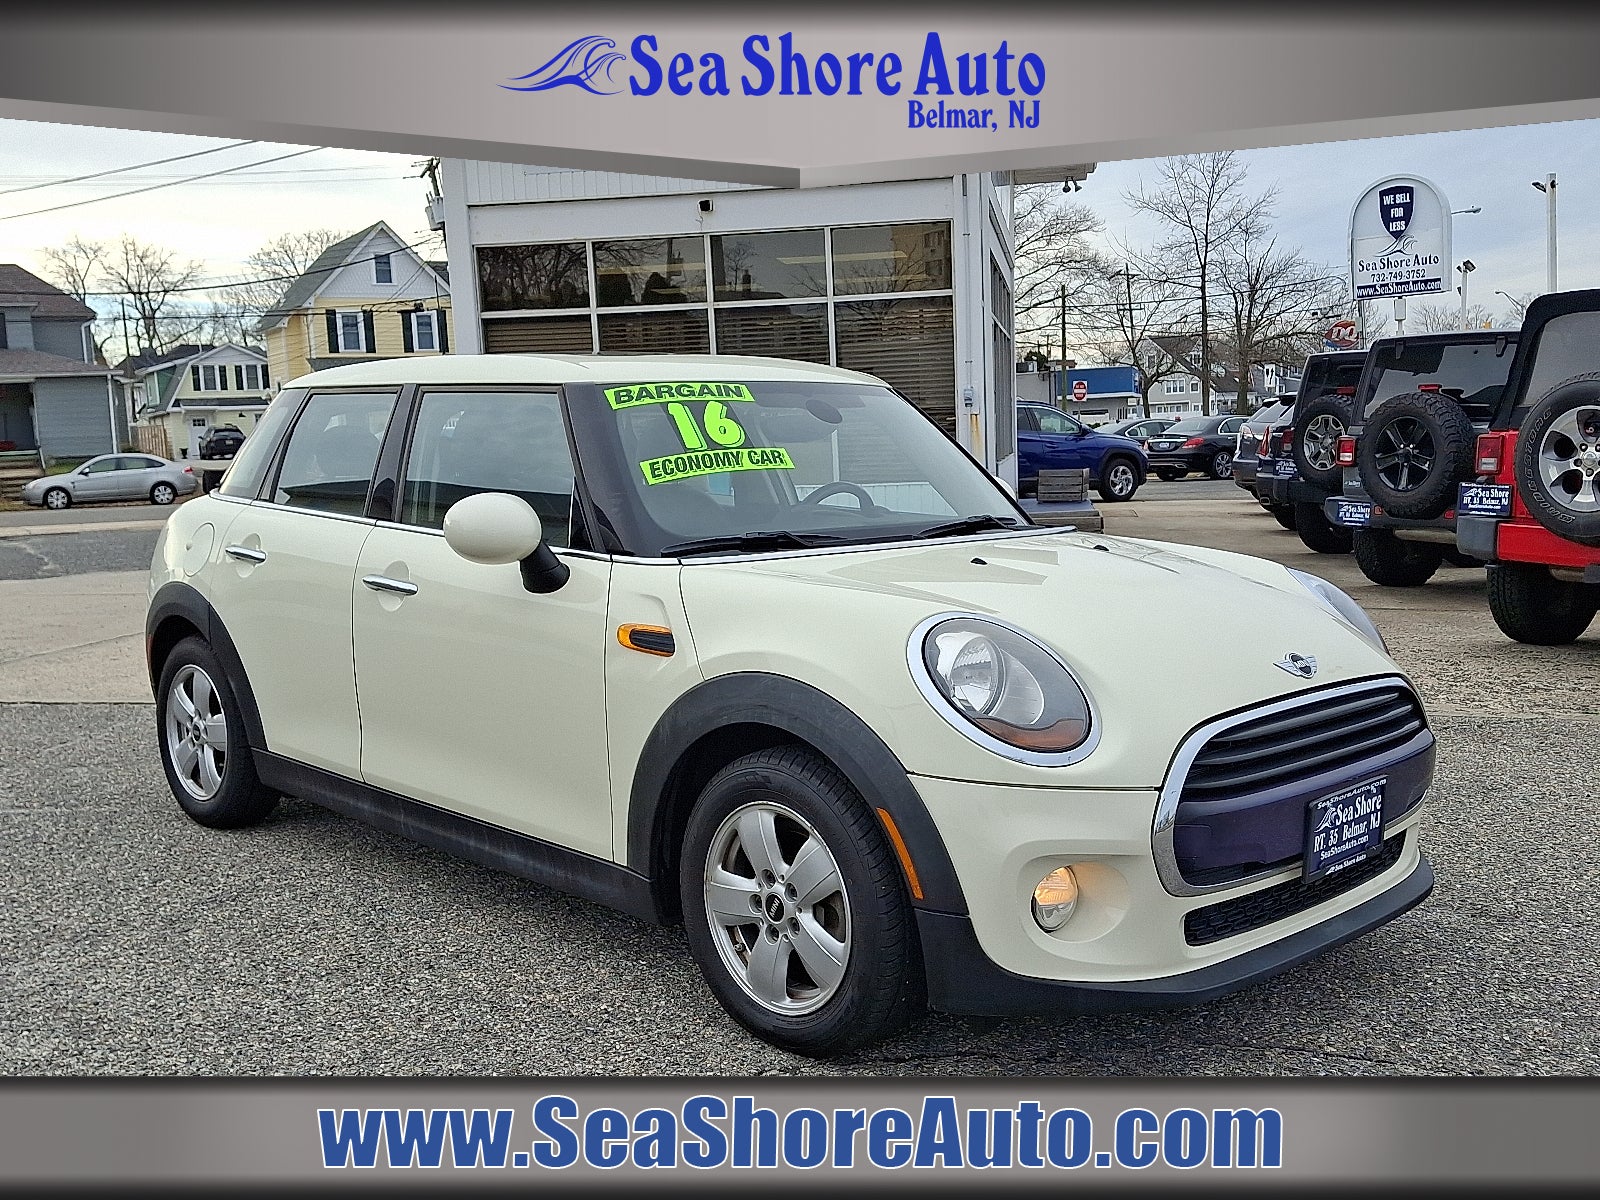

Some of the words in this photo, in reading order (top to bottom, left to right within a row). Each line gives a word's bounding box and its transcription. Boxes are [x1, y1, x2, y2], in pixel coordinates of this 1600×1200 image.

[1383, 194, 1395, 206] WE
[1395, 192, 1410, 204] SELL
[1390, 207, 1404, 218] FOR
[1389, 220, 1405, 231] LESS
[1358, 260, 1377, 273] Sea
[1380, 256, 1411, 270] Shore
[1413, 253, 1440, 267] Auto
[1370, 268, 1426, 283] 732-749-3752
[1356, 280, 1441, 296] www.SeaShoreAuto.com
[613, 384, 744, 404] BARGAIN
[667, 400, 746, 451] 16
[648, 450, 743, 480] ECONOMY
[747, 449, 787, 468] CAR
[1336, 803, 1354, 827] Sea
[1354, 794, 1382, 819] Shore
[1313, 832, 1326, 853] RT.
[1328, 828, 1339, 847] 35
[1342, 821, 1368, 841] Belmar,
[1370, 811, 1381, 830] NJ
